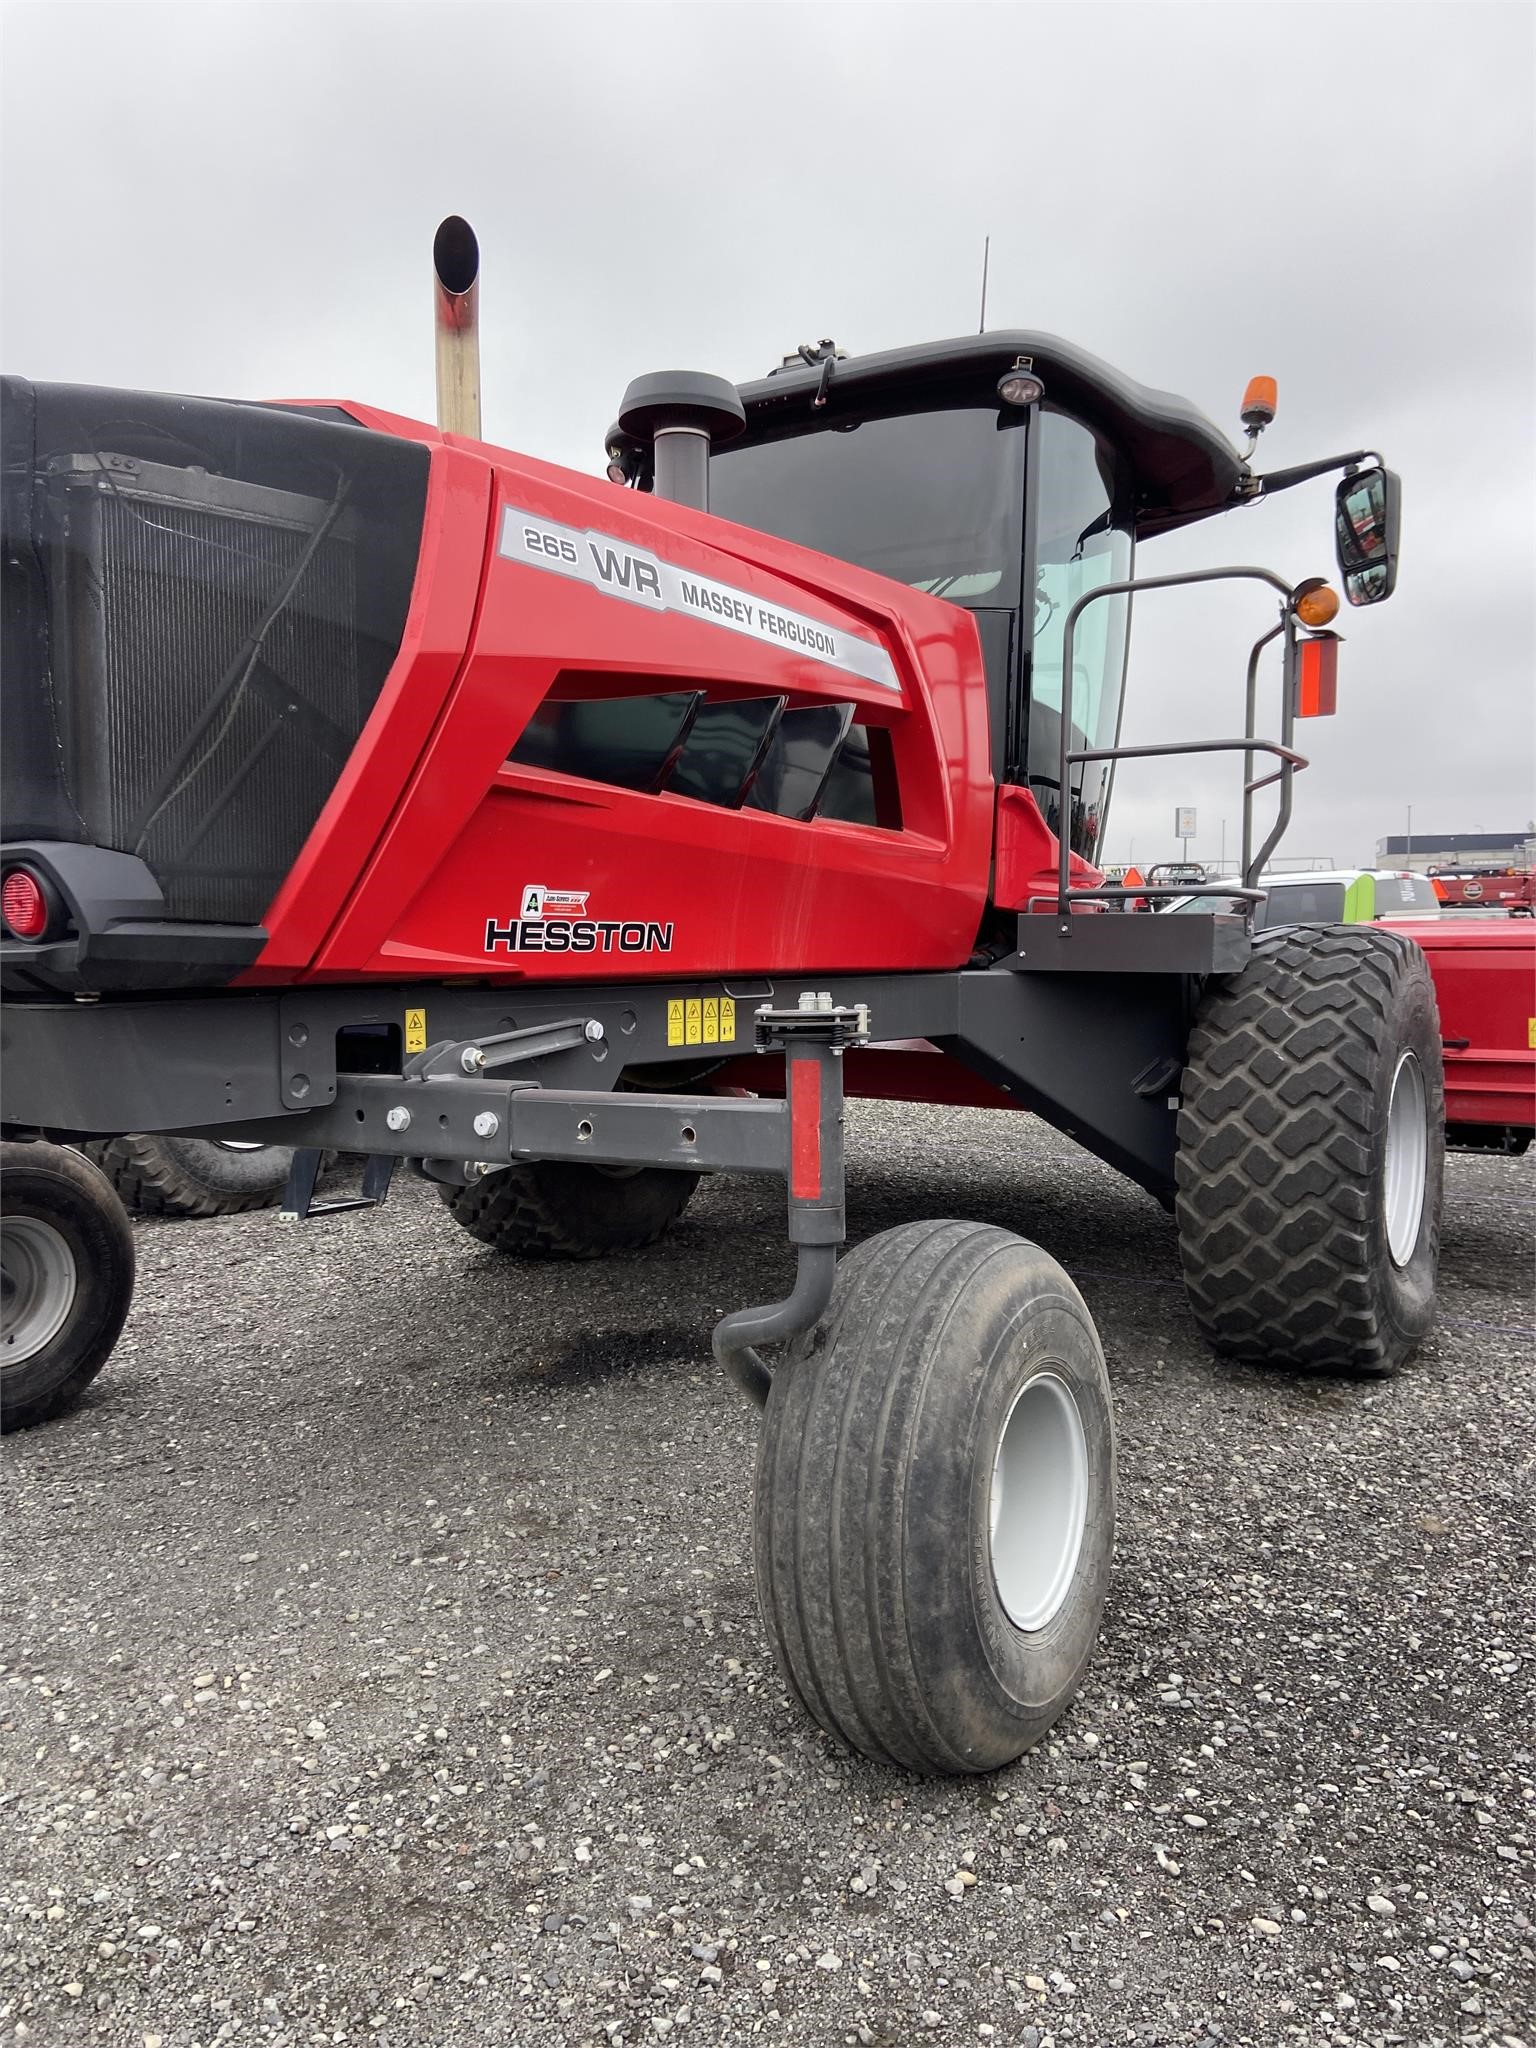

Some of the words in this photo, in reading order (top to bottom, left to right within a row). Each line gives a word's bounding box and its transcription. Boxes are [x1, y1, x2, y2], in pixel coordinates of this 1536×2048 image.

[524, 528, 577, 563] 265
[587, 541, 662, 599] WR
[681, 580, 753, 625] MASSEY
[758, 608, 836, 657] FERGUSON
[485, 919, 673, 952] HESSTON
